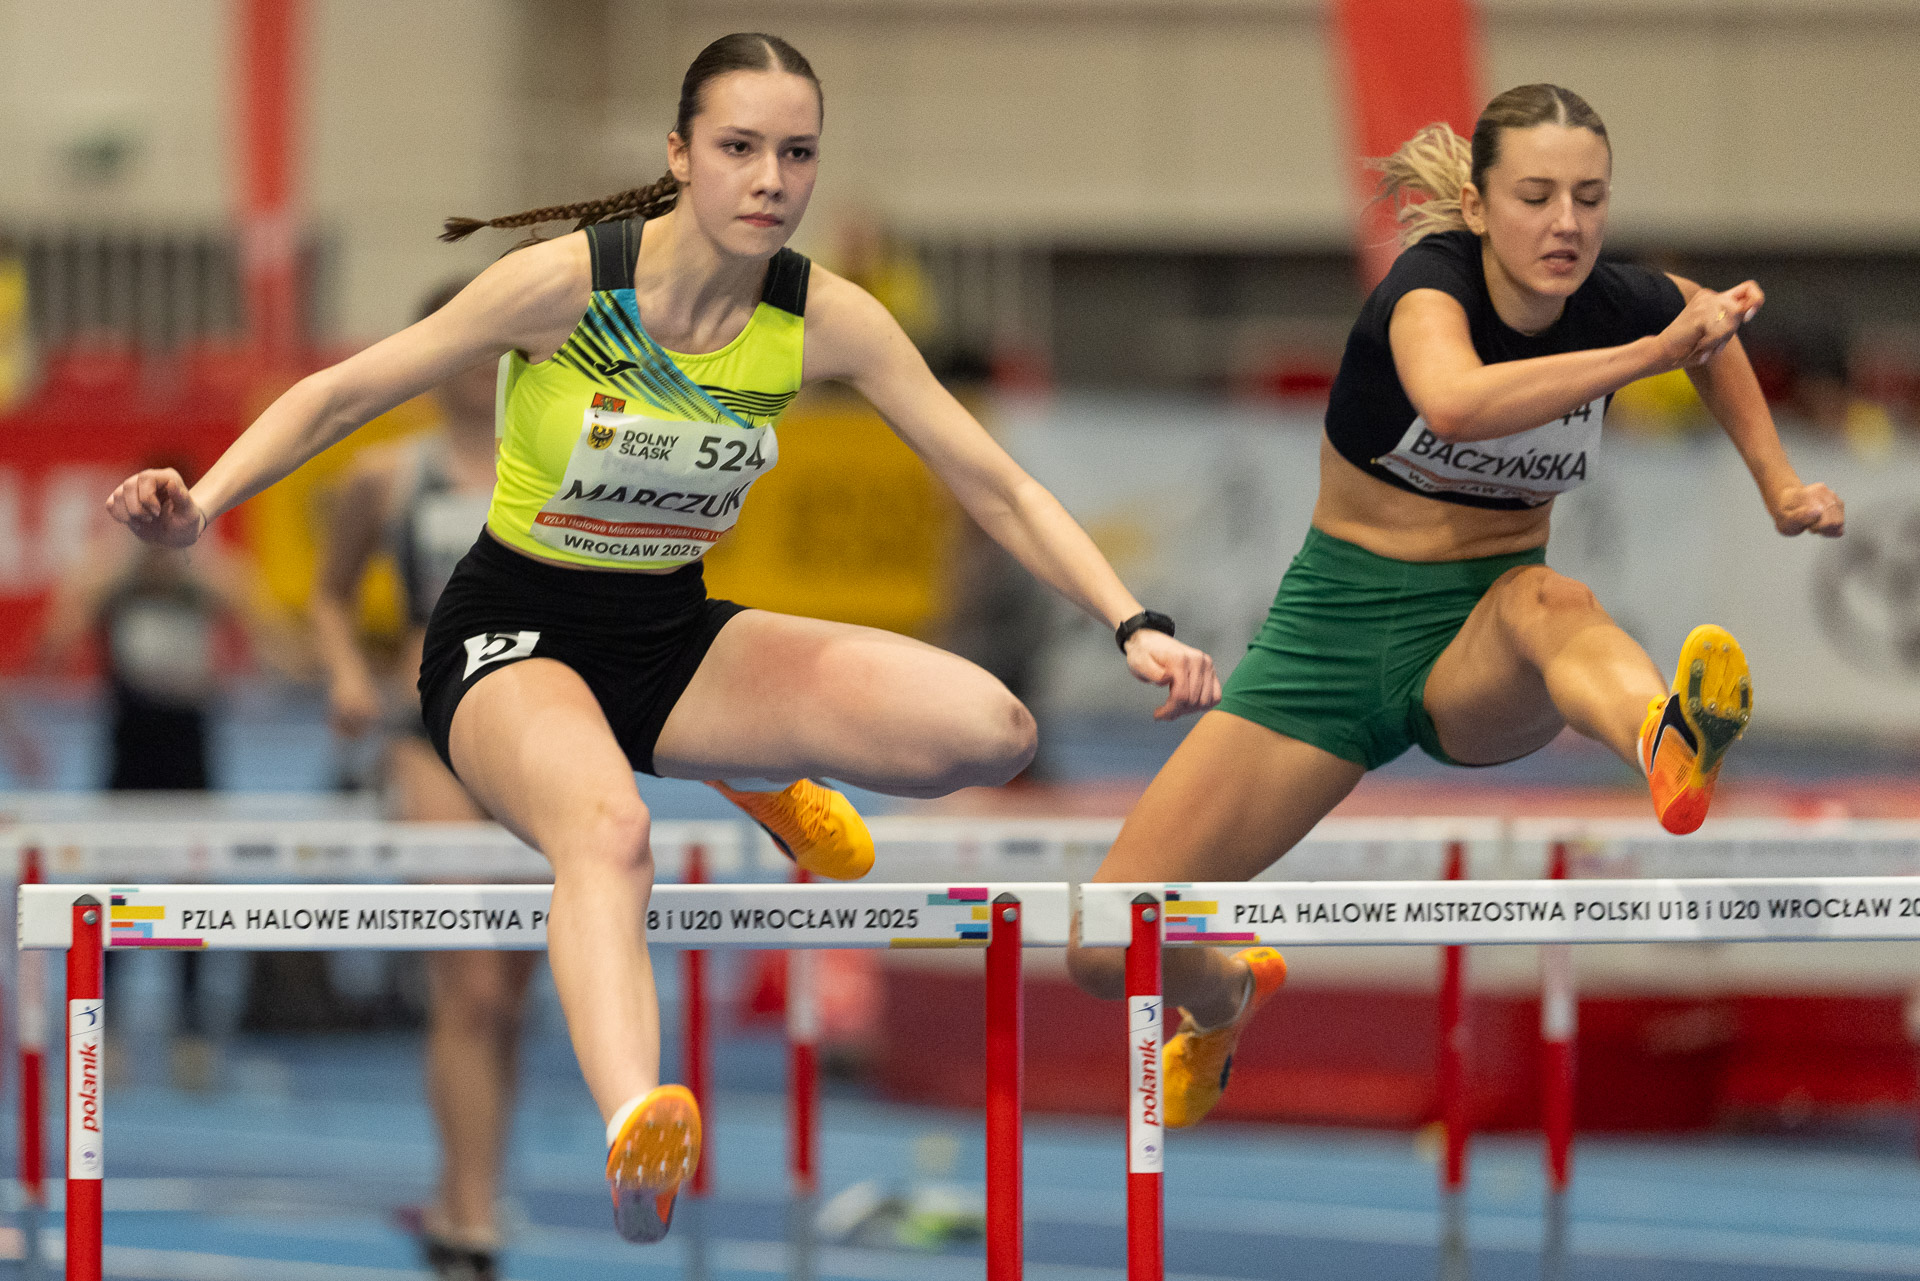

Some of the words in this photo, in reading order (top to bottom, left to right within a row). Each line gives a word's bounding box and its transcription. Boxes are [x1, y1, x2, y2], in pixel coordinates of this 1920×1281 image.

[619, 442, 672, 461] ŚLĄSK
[622, 430, 679, 449] DOLNY
[694, 435, 766, 472] 524
[1409, 428, 1586, 481] BACZYŃSKA
[561, 480, 752, 518] MARCZUK
[543, 515, 567, 526] PZLA
[568, 518, 606, 533] Halowe
[608, 524, 664, 537] Mistrzostwa
[664, 528, 692, 538] Polski
[563, 533, 659, 557] WROCŁAW
[661, 544, 703, 557] 2025
[182, 909, 236, 930] PZLA
[246, 908, 350, 930] HALOWE
[357, 909, 524, 930] MISTRZOSTWA
[680, 908, 722, 930] U20
[730, 907, 858, 930] WROCŁAW
[864, 908, 919, 929] 2025
[1234, 904, 1287, 924] PZLA
[1297, 903, 1397, 923] HALOWE
[1404, 901, 1566, 923] MISTRZOSTWA
[1574, 901, 1651, 921] POLSKI
[1659, 901, 1700, 921] U18
[1705, 900, 1712, 920] i
[1719, 900, 1760, 920] U20
[1767, 898, 1892, 919] WROCŁAW
[78, 1042, 100, 1132] polanik
[1138, 1037, 1159, 1126] polanik
